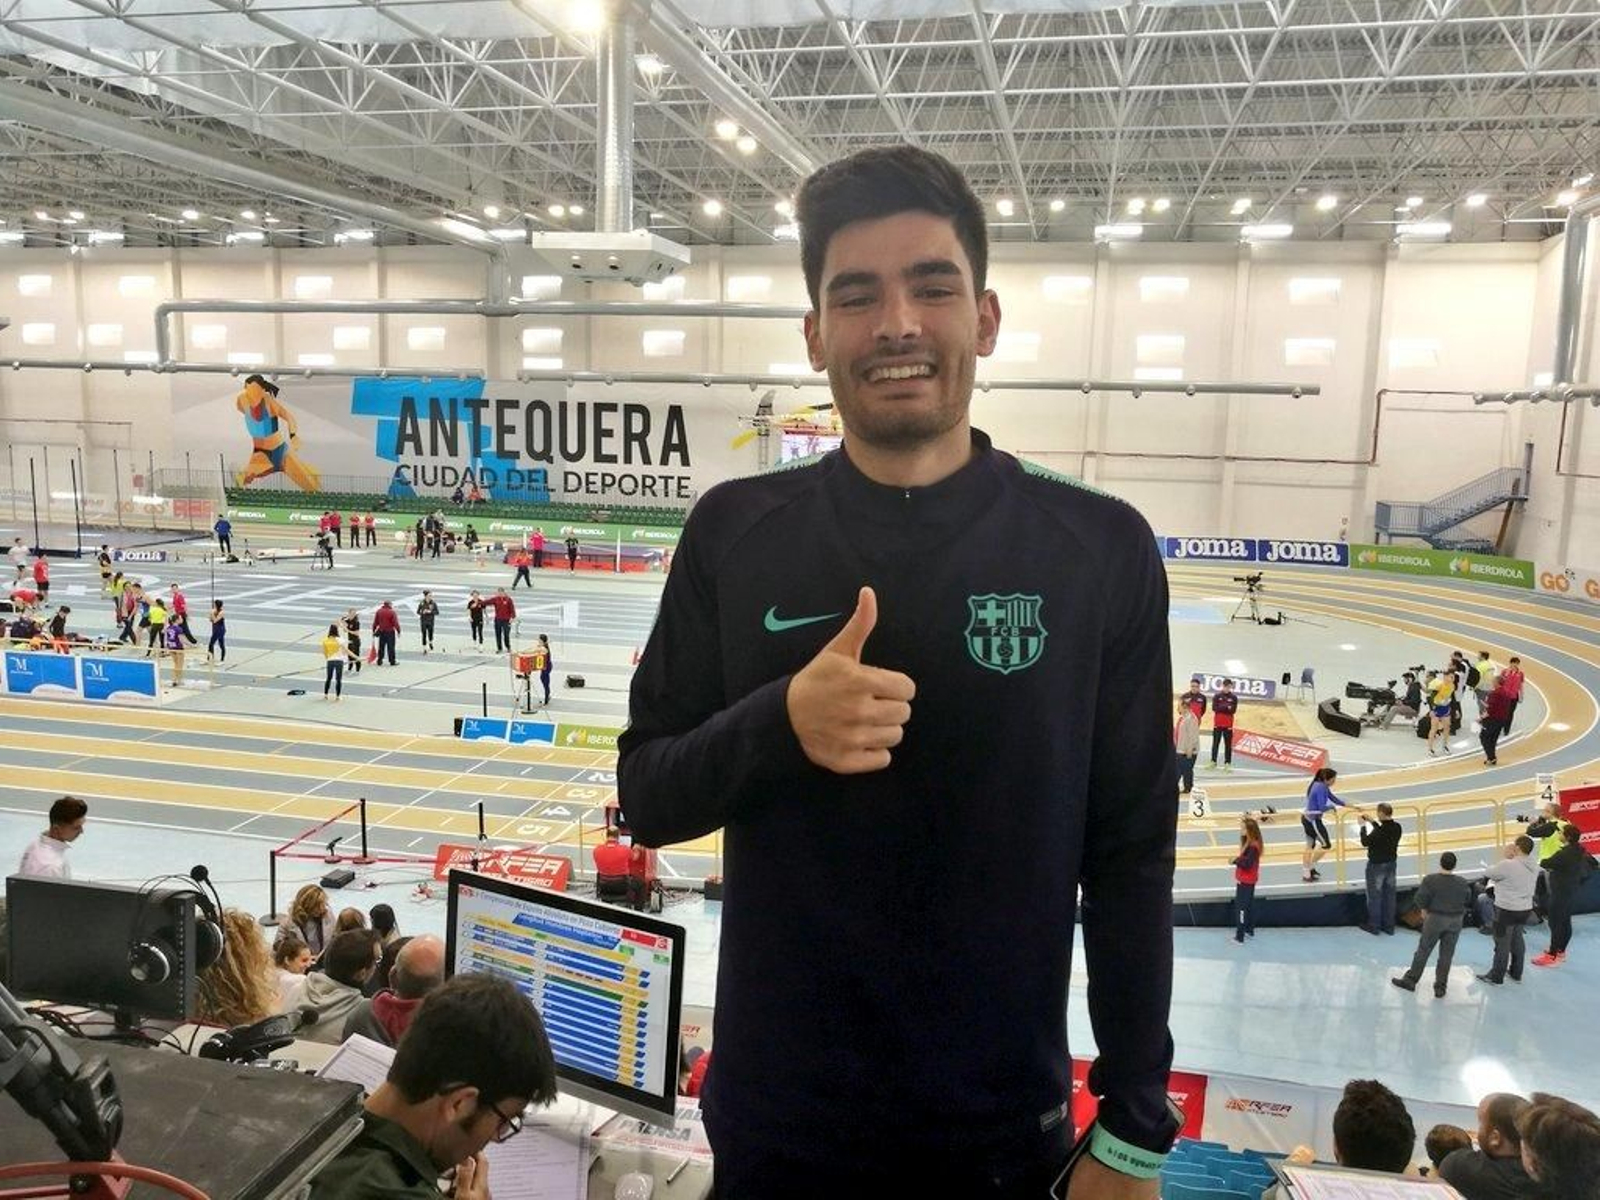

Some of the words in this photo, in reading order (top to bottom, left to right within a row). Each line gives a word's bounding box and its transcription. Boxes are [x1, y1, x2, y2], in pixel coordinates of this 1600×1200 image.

[395, 396, 691, 467] ANTEQUERA
[397, 464, 499, 490] CIUDAD
[507, 467, 556, 492] DEL
[564, 471, 691, 499] DEPORTE
[1377, 553, 1431, 568] IBERDROLA
[1471, 563, 1525, 581] IBERDROLA
[1266, 738, 1323, 762] RFEA
[1541, 784, 1554, 802] 4
[541, 805, 572, 816] 4
[1193, 799, 1205, 818] 3
